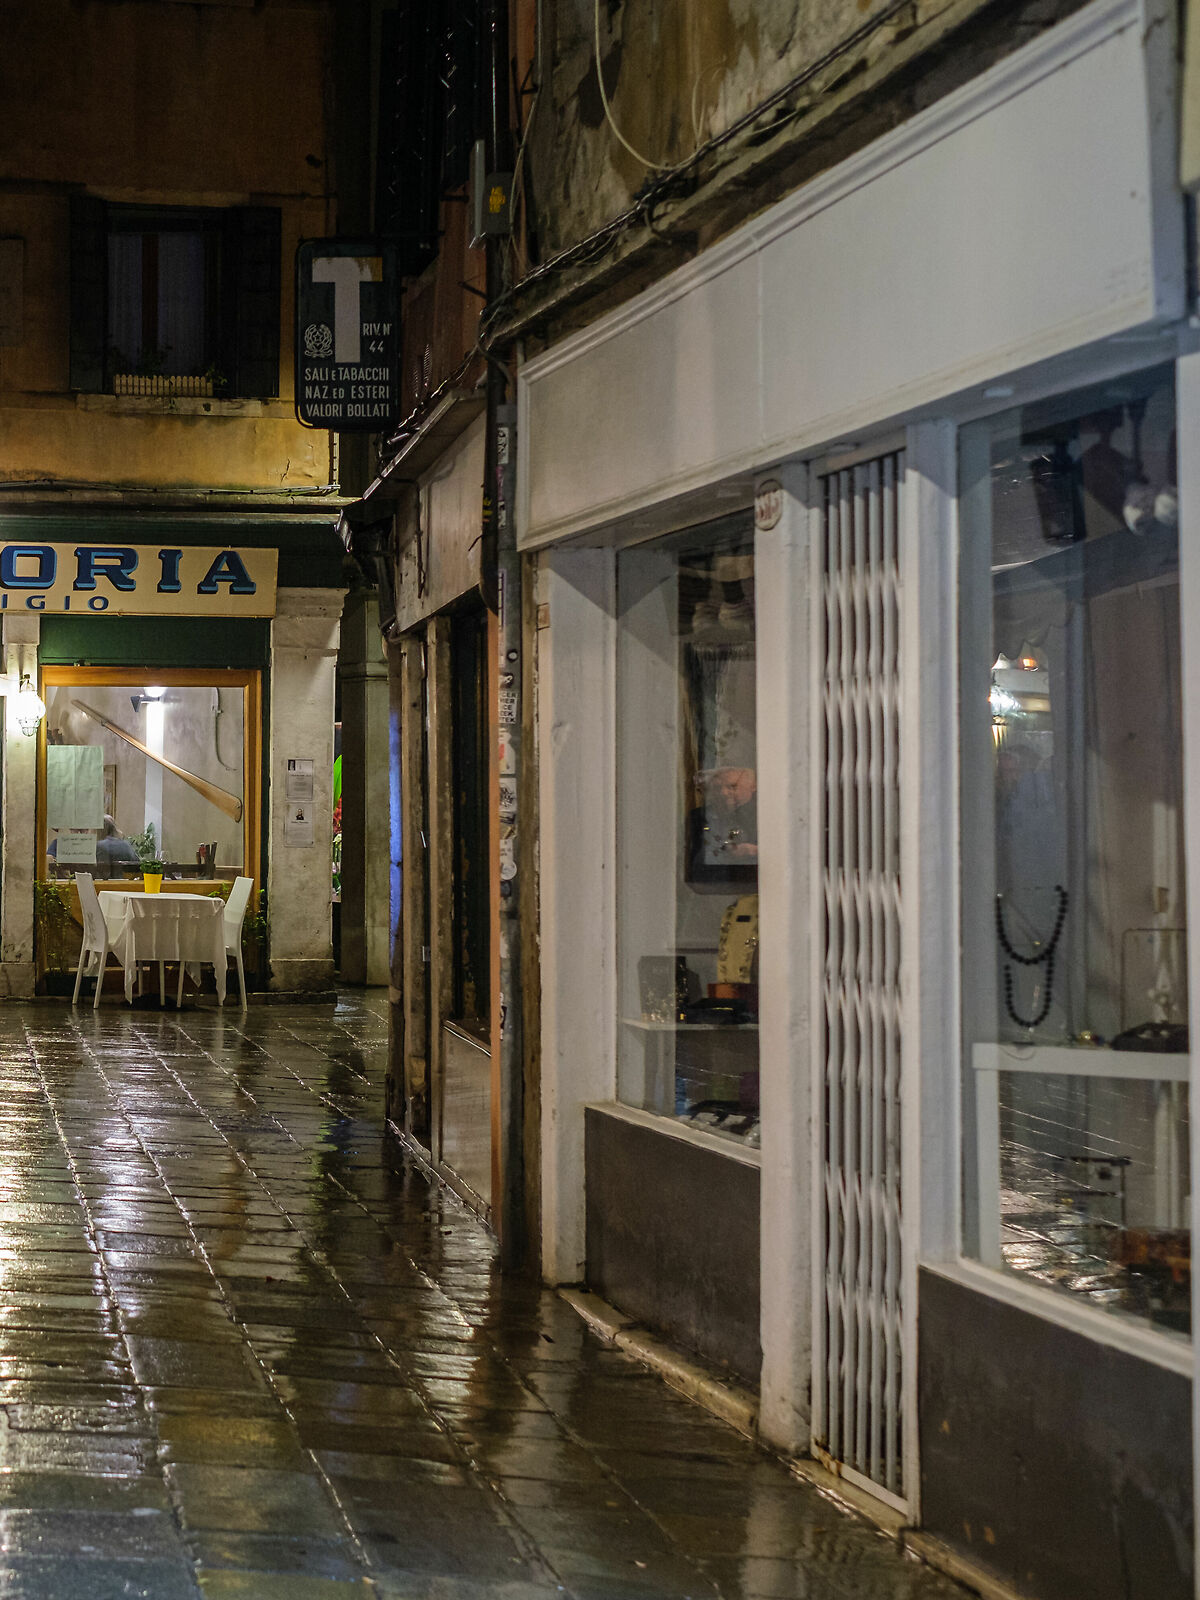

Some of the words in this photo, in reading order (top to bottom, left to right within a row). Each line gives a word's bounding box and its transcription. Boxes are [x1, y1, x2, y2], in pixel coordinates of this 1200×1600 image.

[312, 256, 383, 363] T
[369, 340, 384, 353] 44
[304, 367, 329, 381] SALI
[337, 367, 390, 381] TABACCHI
[351, 385, 390, 399] ESTERI
[306, 403, 343, 417] VALORI
[347, 403, 390, 417] BOLLATI
